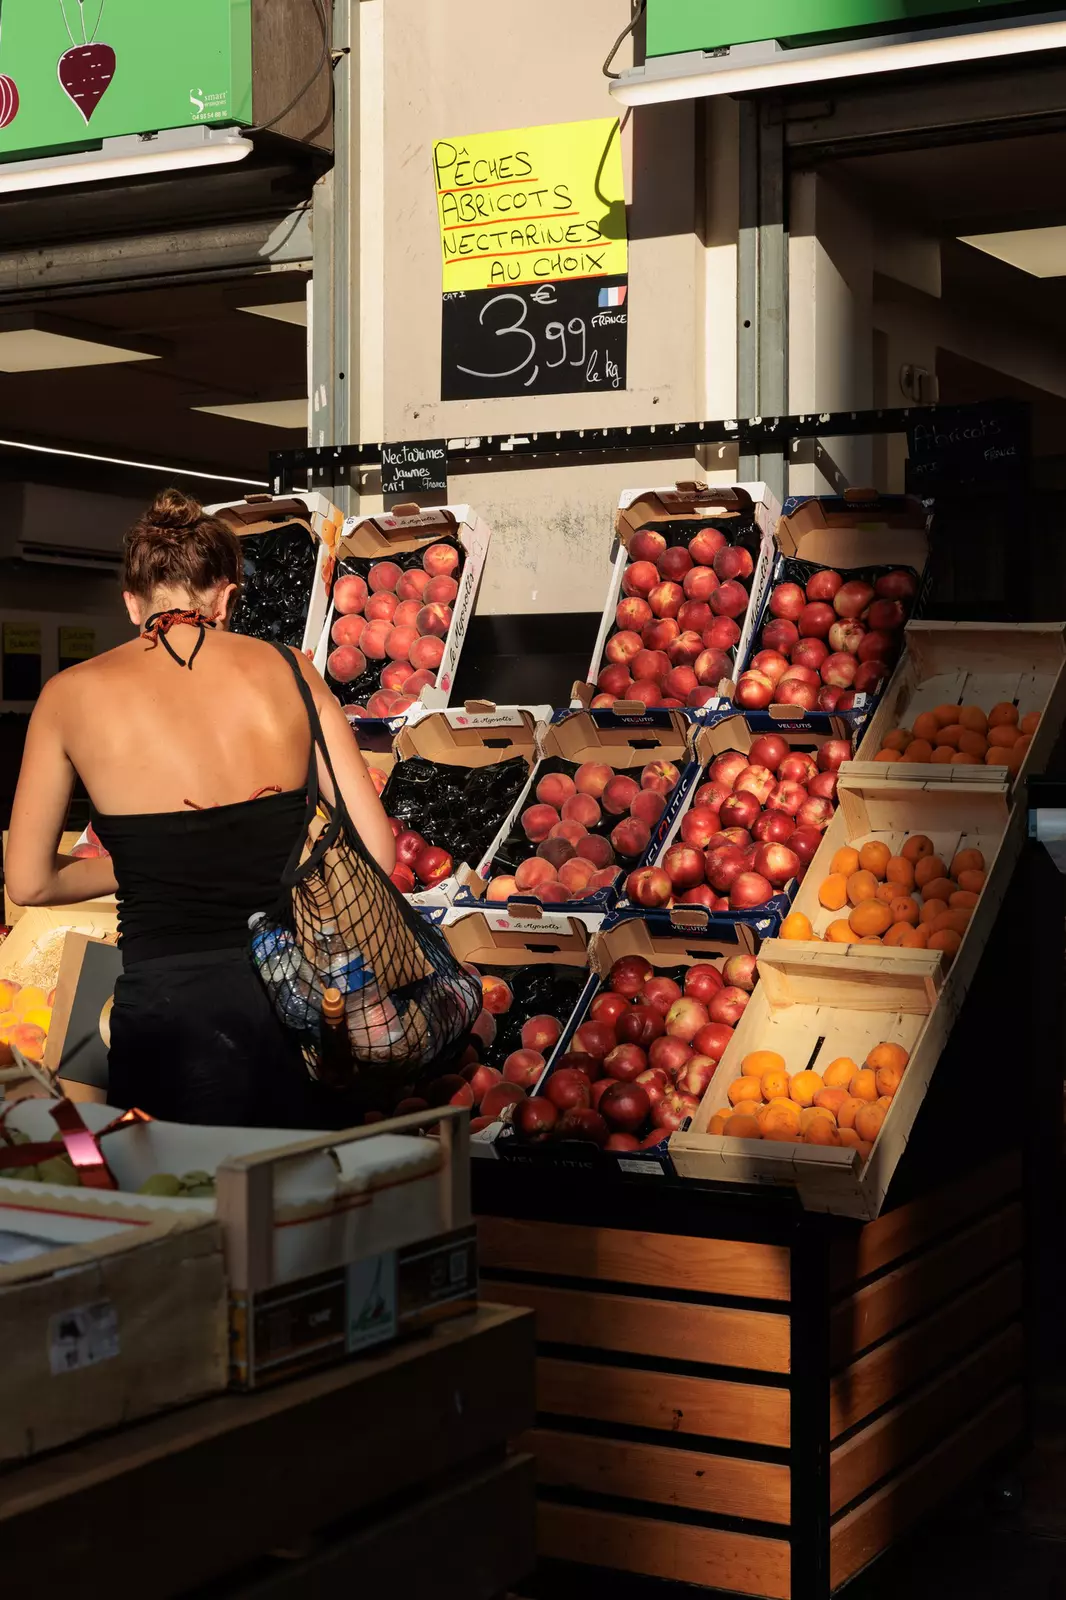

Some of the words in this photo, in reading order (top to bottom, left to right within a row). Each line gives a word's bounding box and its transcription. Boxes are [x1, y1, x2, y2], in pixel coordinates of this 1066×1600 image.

[434, 142, 533, 189] PÊCHES
[441, 184, 573, 225] ABRICOTS
[443, 220, 602, 258] NECTARINES
[490, 261, 521, 282] AU
[533, 253, 606, 276] CHOIX
[591, 311, 627, 328] FRANCE
[605, 349, 622, 388] kg
